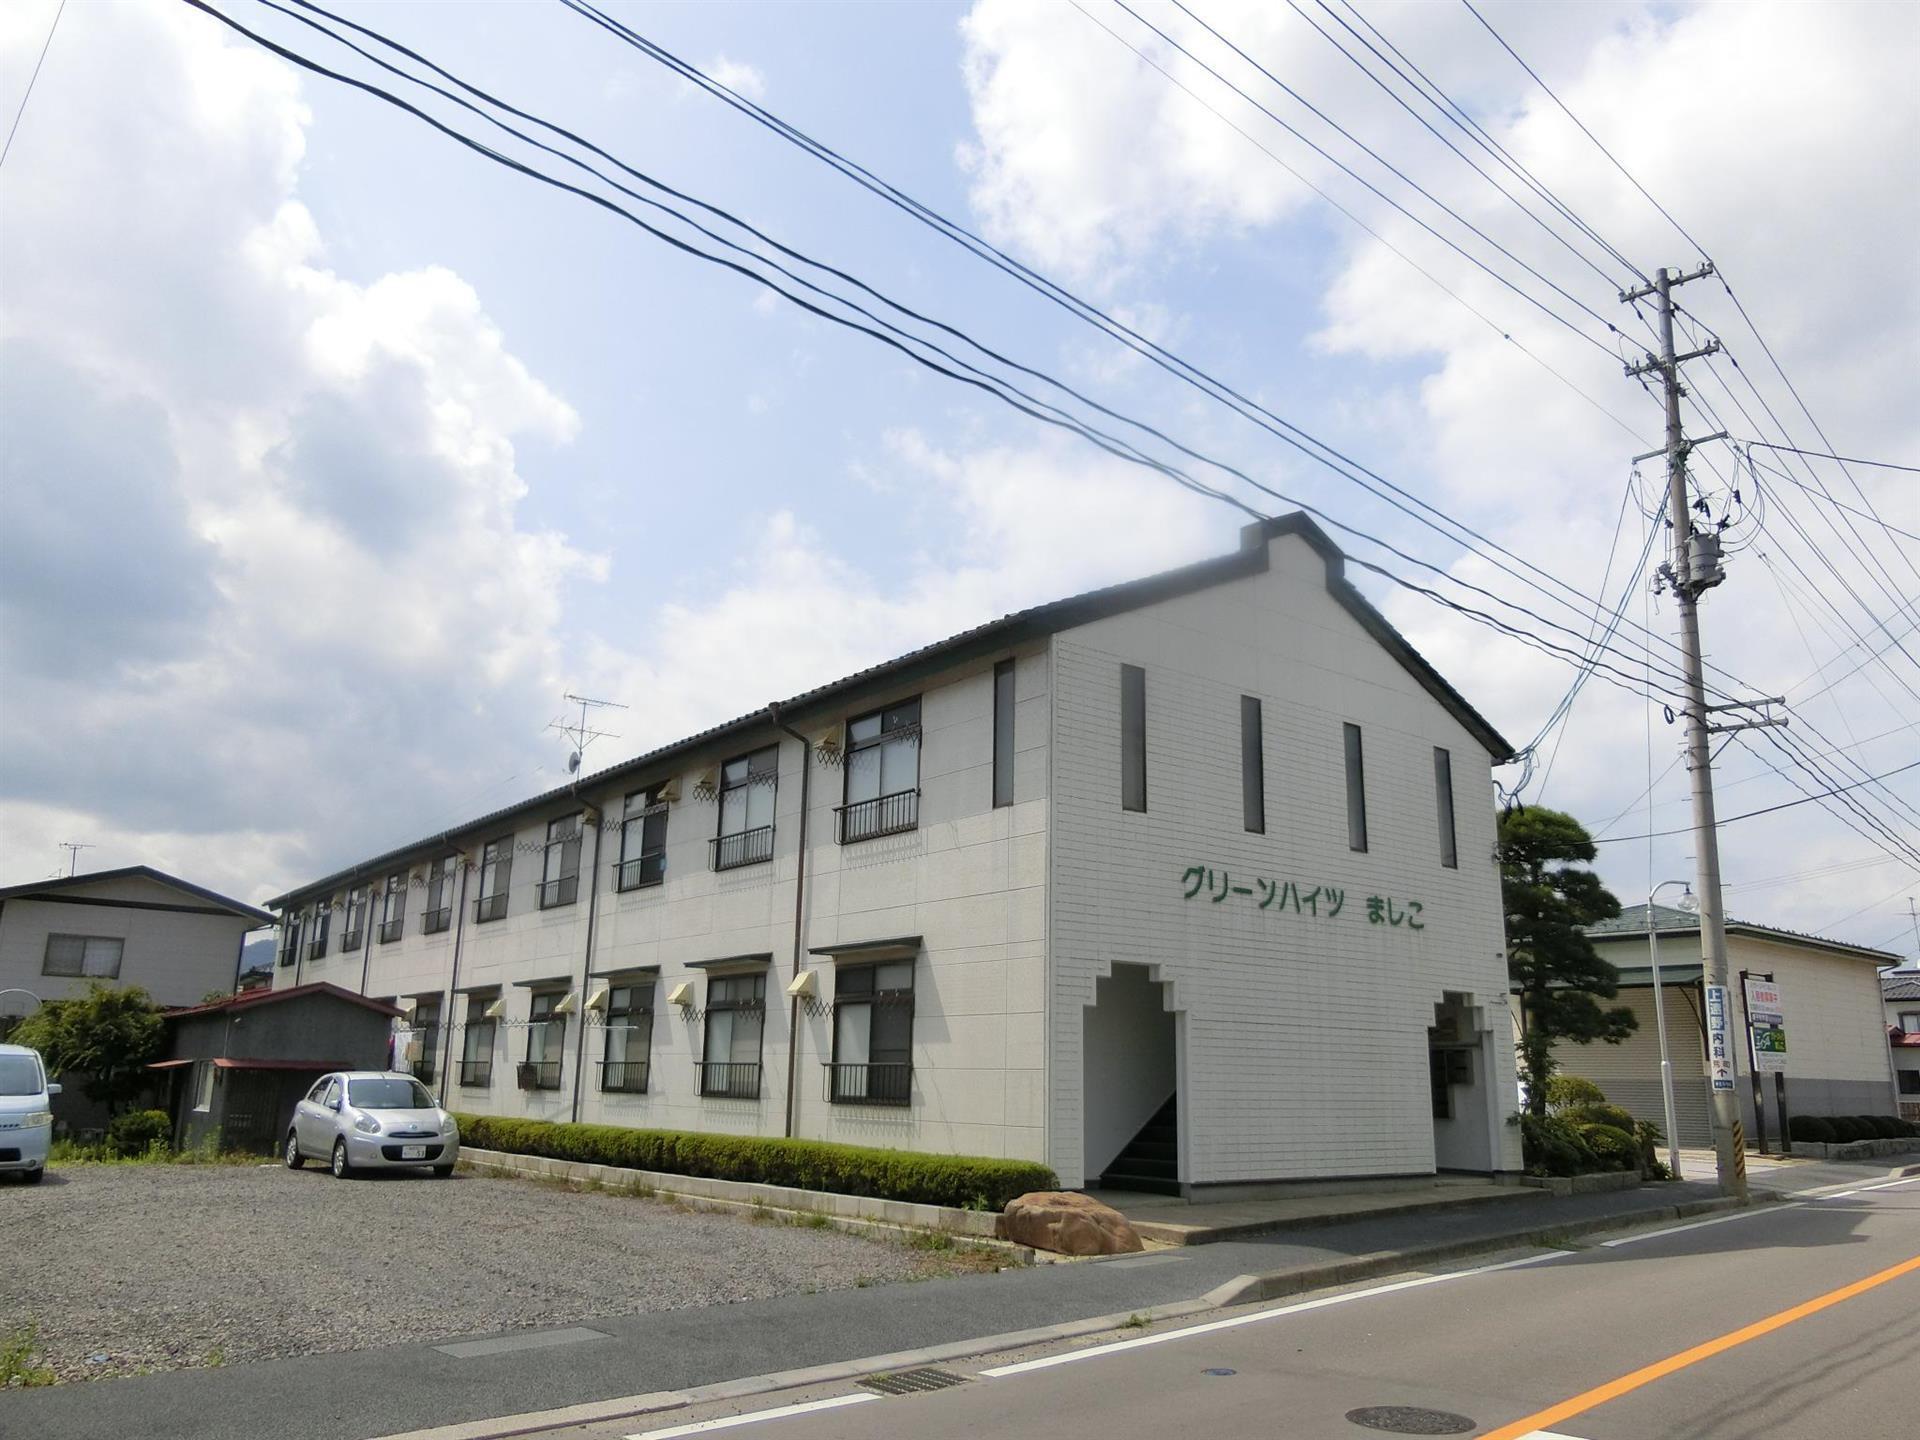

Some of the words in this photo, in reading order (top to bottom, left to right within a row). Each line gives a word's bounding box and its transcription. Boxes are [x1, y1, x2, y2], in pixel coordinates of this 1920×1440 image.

[1181, 865, 1344, 917] グリーンハイツ
[1366, 894, 1425, 930] ましこ
